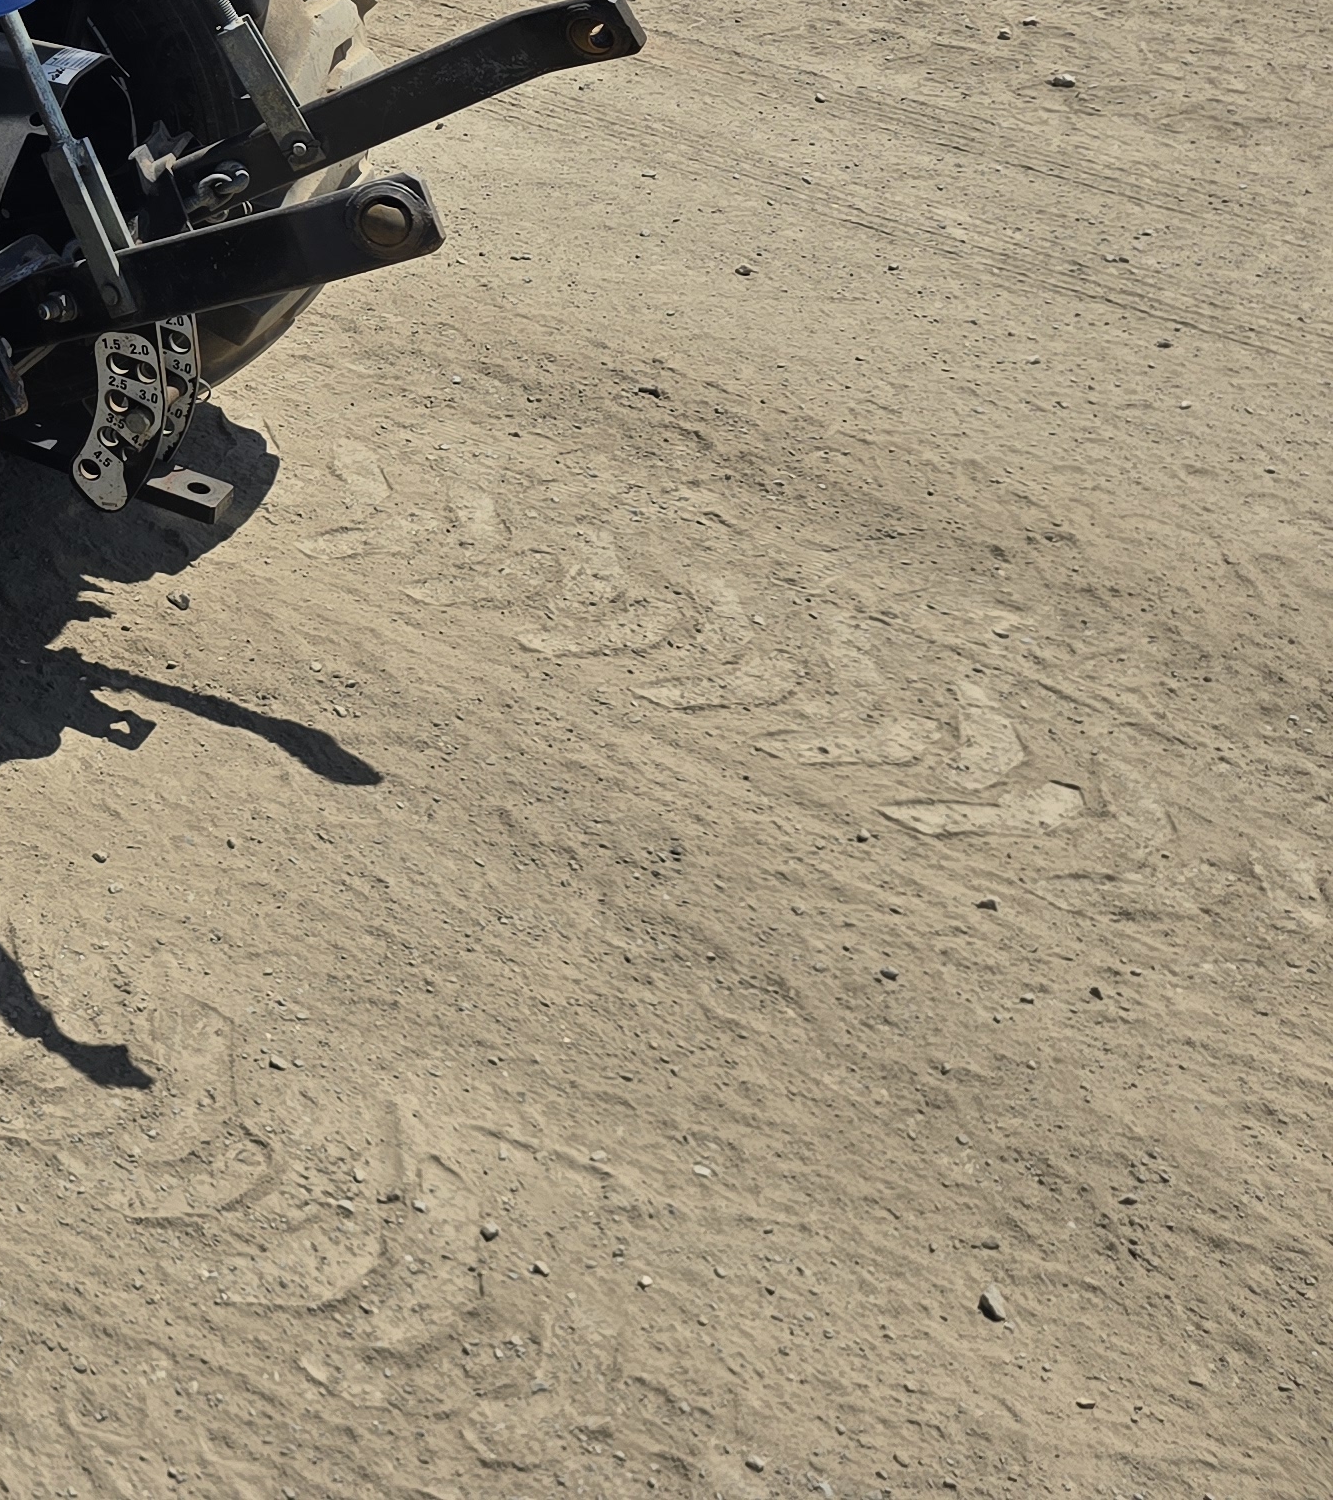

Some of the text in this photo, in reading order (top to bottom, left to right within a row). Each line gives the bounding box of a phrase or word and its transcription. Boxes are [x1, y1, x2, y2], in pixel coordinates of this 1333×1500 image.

[102, 338, 149, 355] 1.5 2.0
[172, 359, 192, 375] 3.0
[108, 376, 158, 404] 2.5 3.0
[106, 412, 125, 429] 3.5
[93, 450, 113, 467] 4.5
